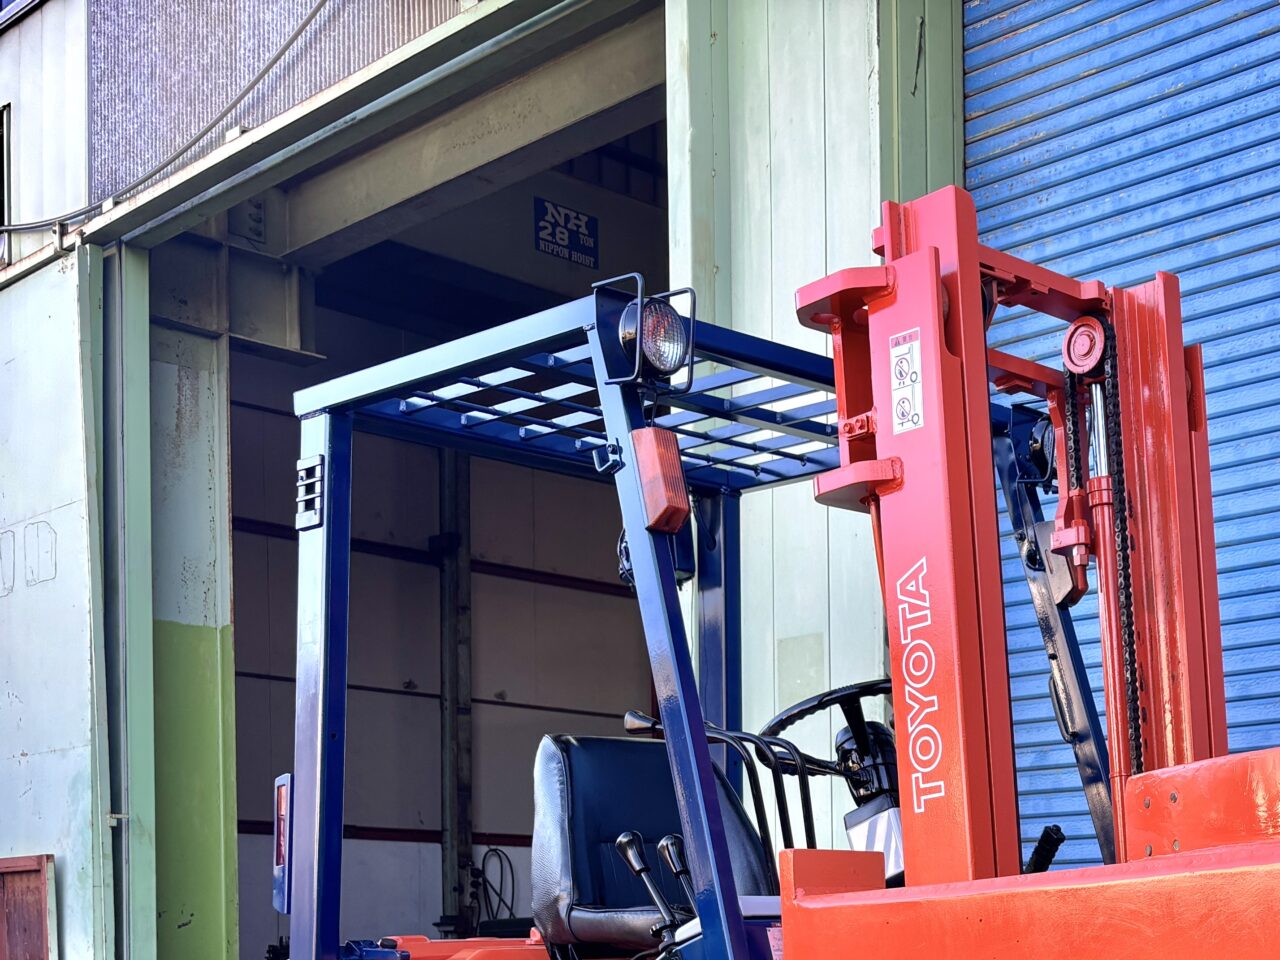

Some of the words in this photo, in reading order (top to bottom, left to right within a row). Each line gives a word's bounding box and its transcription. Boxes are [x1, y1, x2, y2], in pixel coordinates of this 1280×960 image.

[544, 201, 588, 234] NH
[539, 221, 569, 245] 2.8
[579, 235, 594, 247] TON
[539, 240, 569, 258] NIPPON
[571, 251, 594, 267] HOIST
[897, 556, 945, 813] TOYOTA
